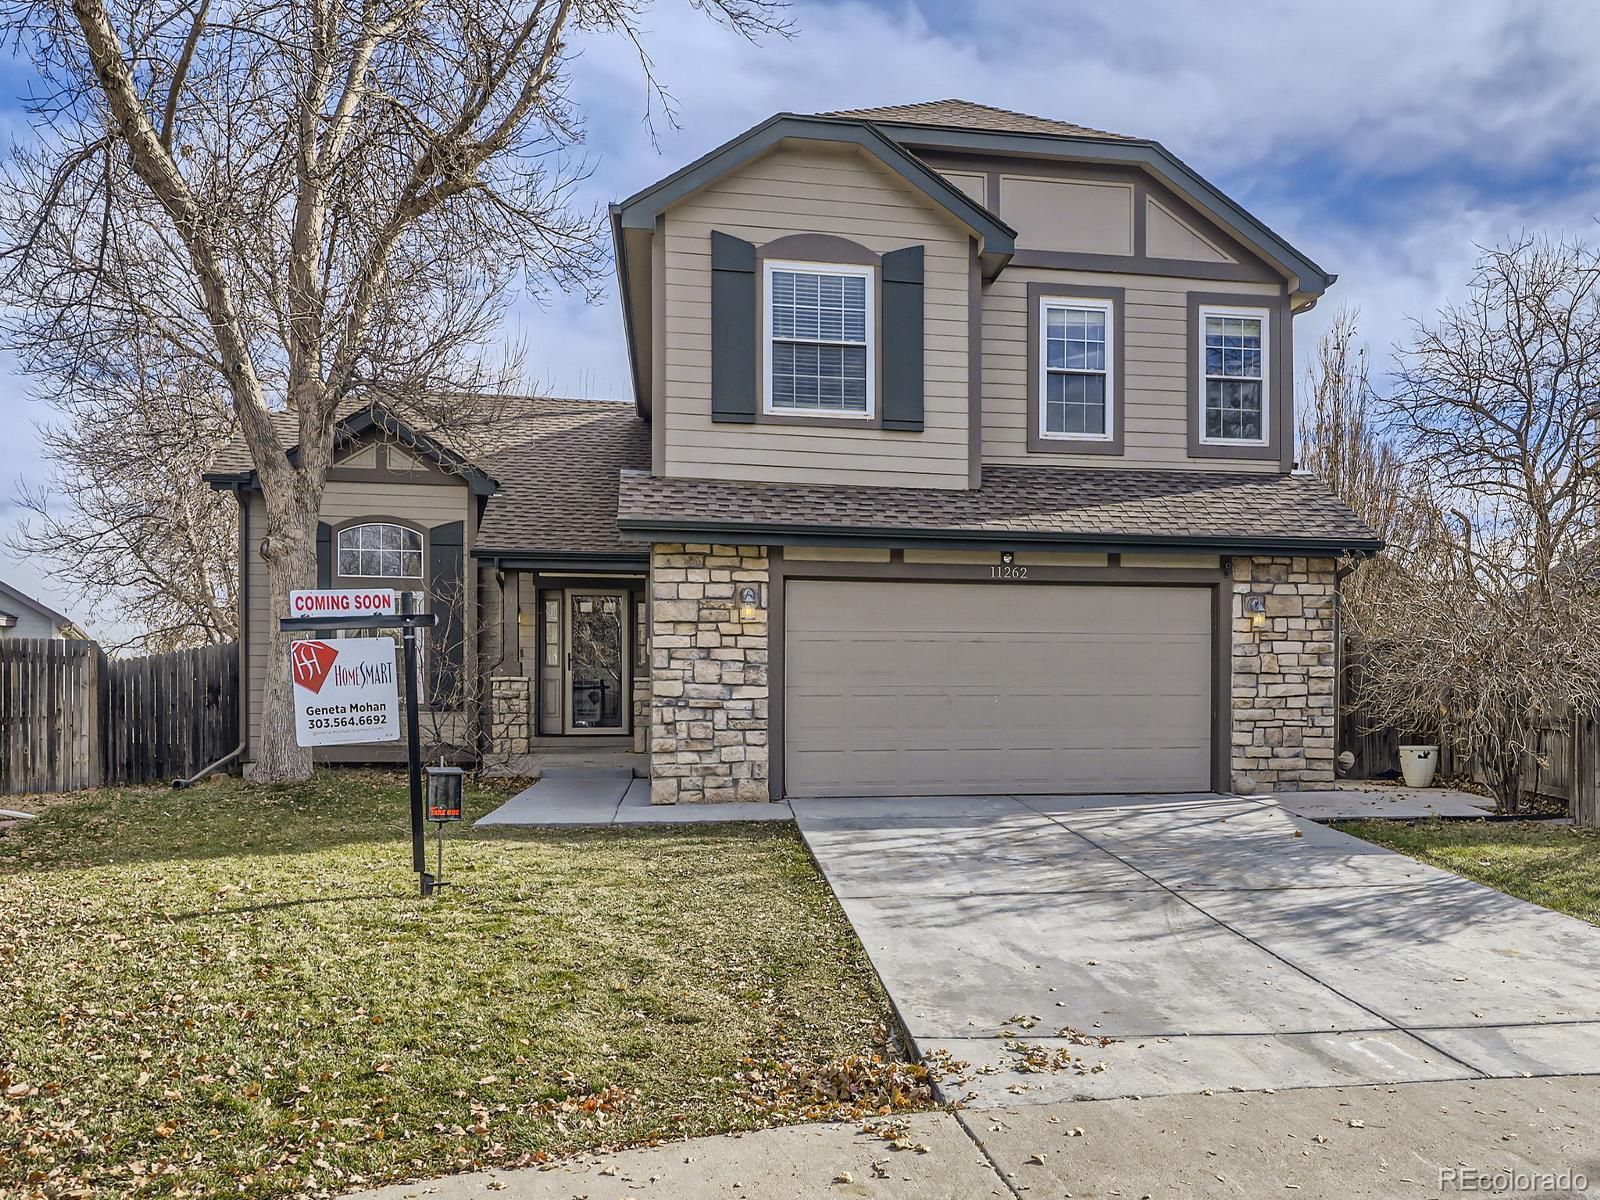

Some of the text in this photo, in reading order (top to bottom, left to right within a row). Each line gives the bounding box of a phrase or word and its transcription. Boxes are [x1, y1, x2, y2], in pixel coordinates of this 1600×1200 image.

[991, 566, 1027, 578] 11262
[295, 594, 391, 611] COMING SOON
[306, 702, 386, 716] Geneta Mohan
[308, 715, 387, 729] 303.564.6692
